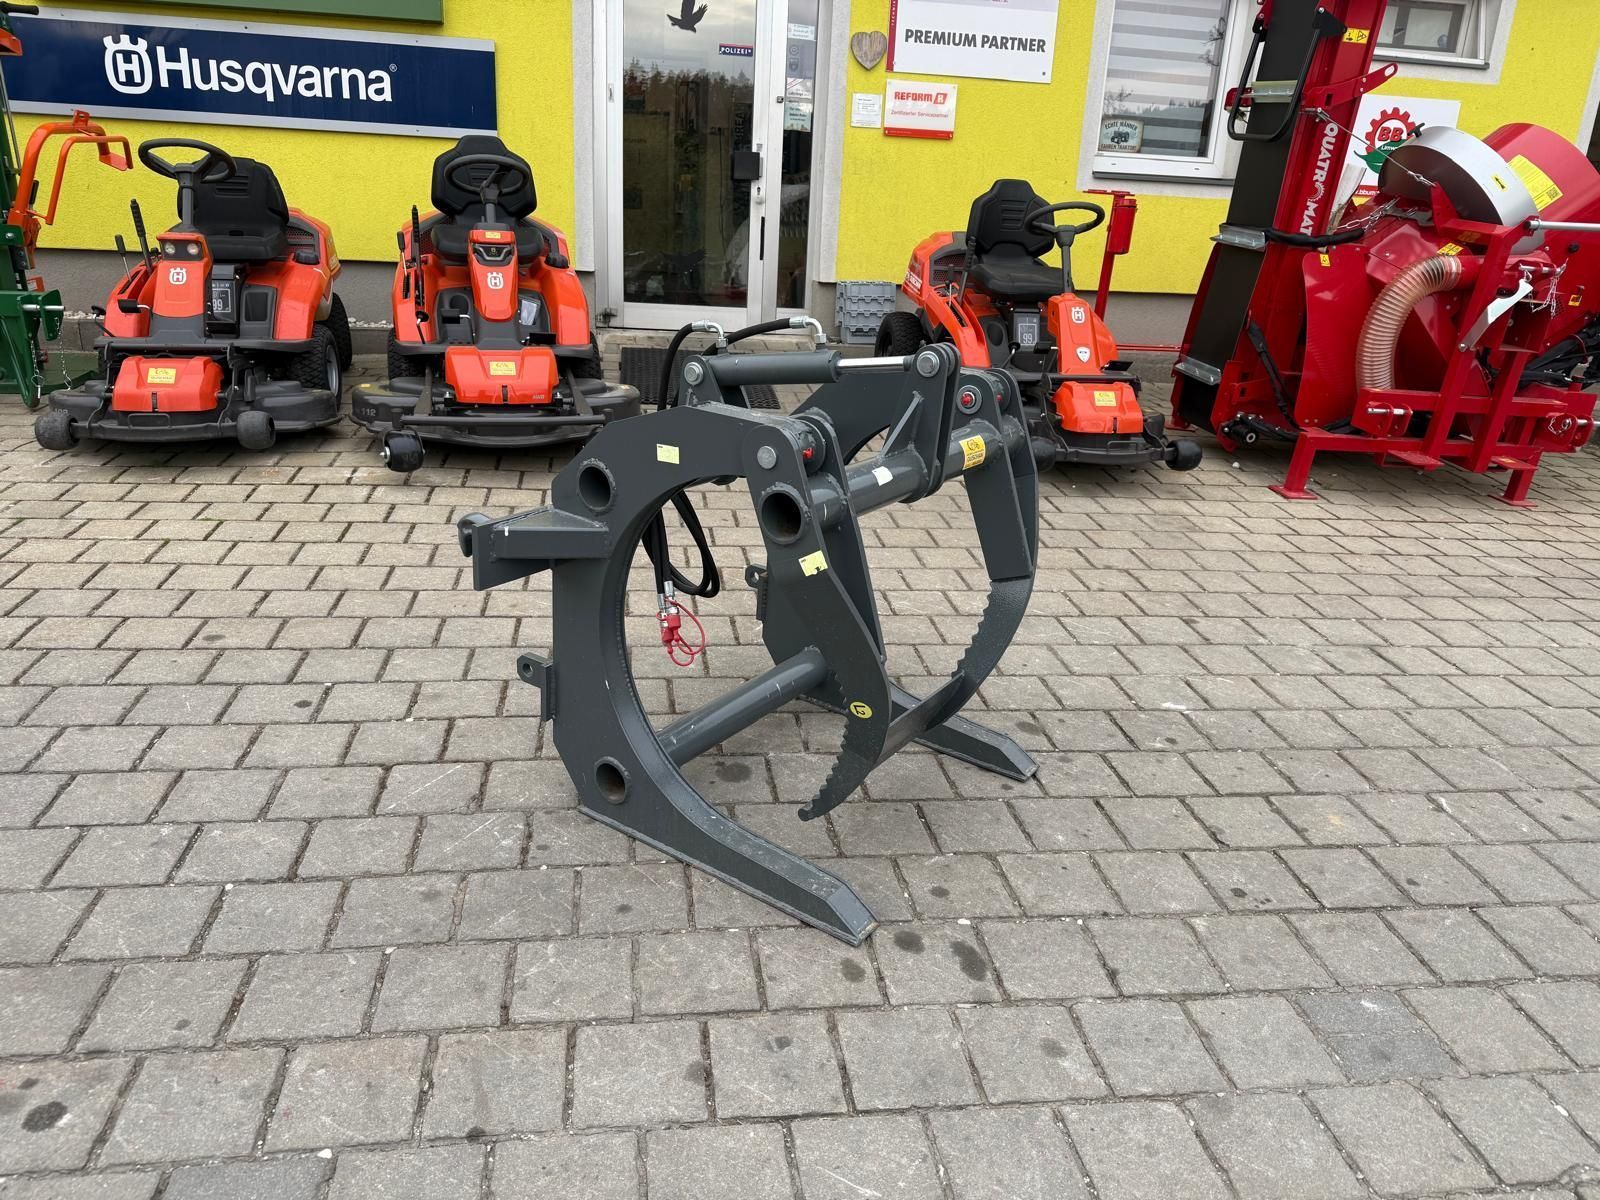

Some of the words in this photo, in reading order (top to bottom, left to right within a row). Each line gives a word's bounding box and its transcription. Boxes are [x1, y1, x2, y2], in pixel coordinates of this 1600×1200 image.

[904, 28, 977, 48] PREMIUM
[980, 34, 1046, 53] PARTNER
[894, 91, 933, 102] REFORM
[1104, 121, 1119, 129] ECHTE
[1377, 126, 1404, 142] BB
[361, 408, 376, 417] 112
